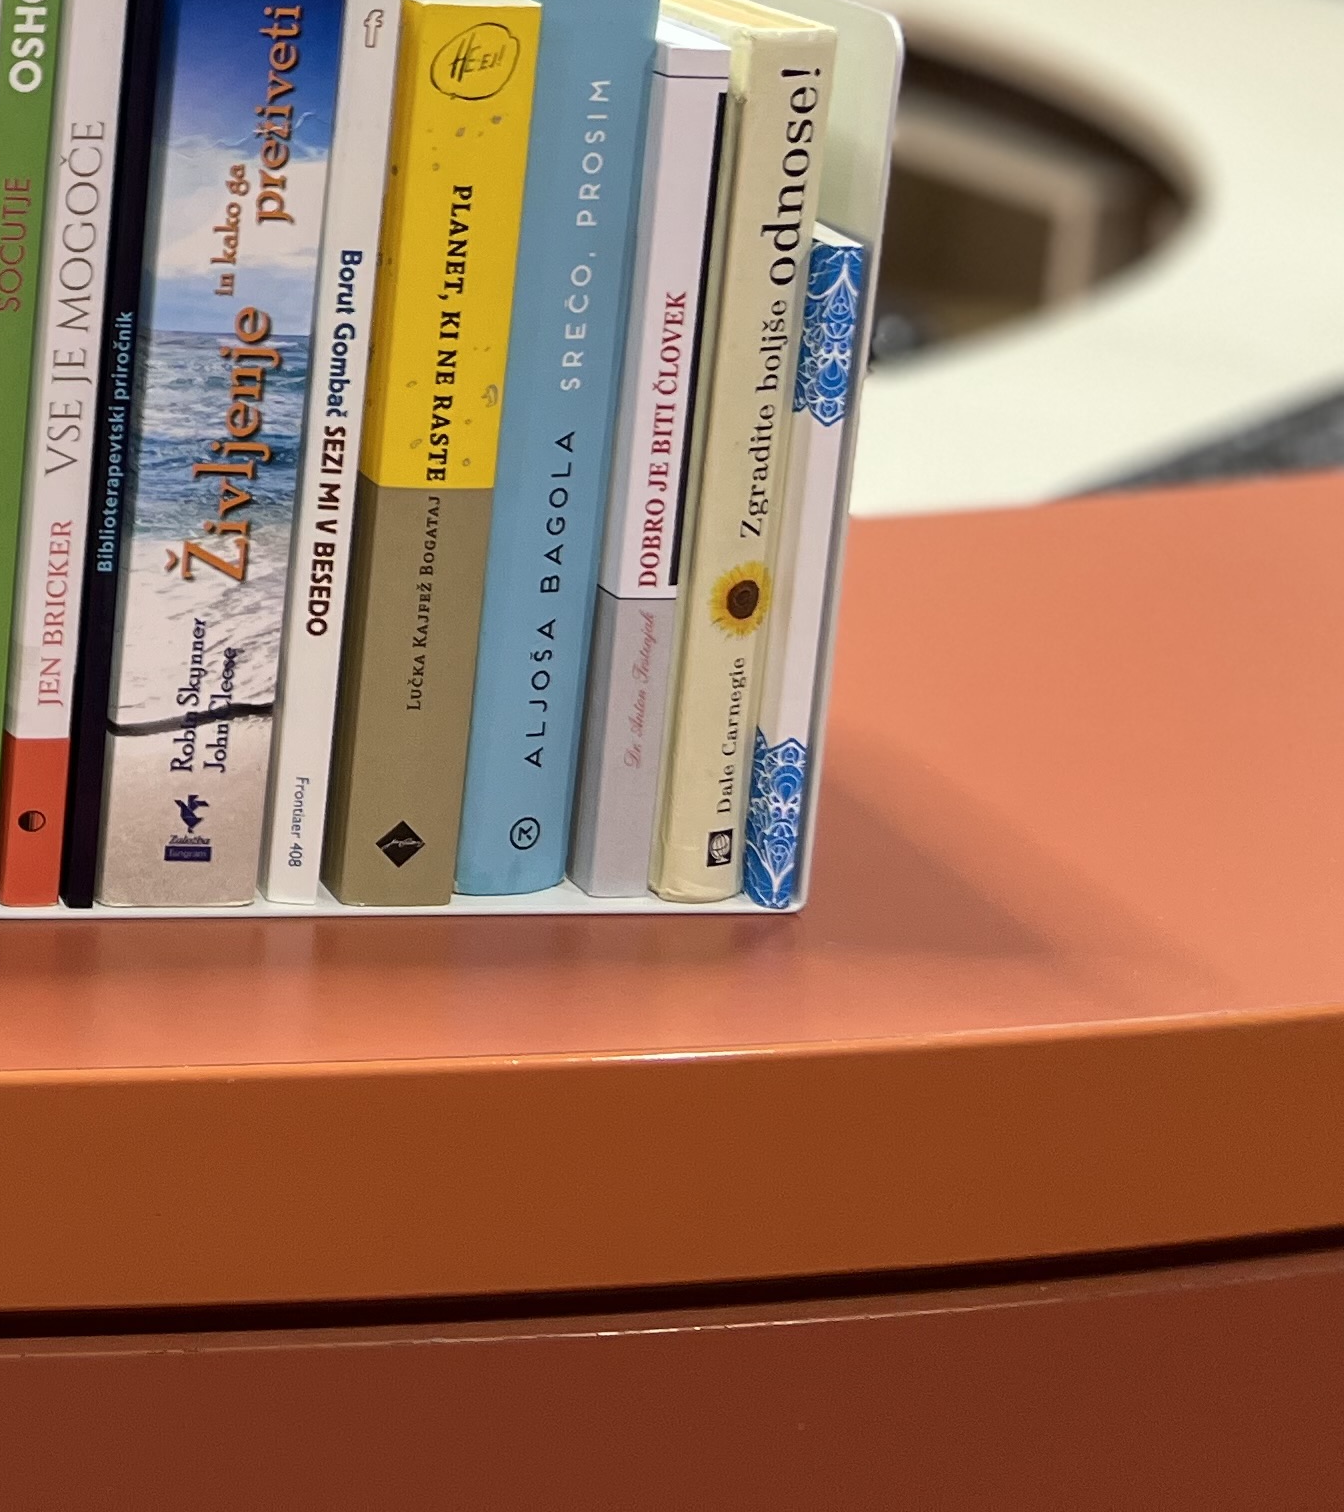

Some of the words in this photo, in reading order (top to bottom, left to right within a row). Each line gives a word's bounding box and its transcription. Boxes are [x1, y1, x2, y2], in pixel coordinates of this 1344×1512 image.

[256, 5, 304, 226] preživeti
[575, 80, 611, 226] PROSIM
[760, 67, 823, 287] odnose!
[55, 121, 105, 332] MOGOČE
[210, 201, 242, 266] kako
[437, 184, 473, 301] PLANET,
[214, 272, 236, 298] in
[335, 249, 363, 315] Borut
[439, 310, 461, 340] KI
[51, 347, 92, 385] JE
[110, 311, 133, 400] priročnik
[325, 322, 356, 418] Gombač
[435, 349, 458, 385] NE
[652, 292, 686, 395] ČLOVEK
[755, 300, 788, 392] boljše
[44, 399, 83, 475] VSE
[164, 305, 282, 585] Življenje
[320, 425, 346, 475] SEZI
[426, 395, 453, 481] RASTE
[650, 403, 675, 455] BITI
[739, 404, 775, 538] Zgradite
[96, 405, 125, 572] Biblioterapevtski
[317, 482, 341, 511] MI
[539, 431, 575, 593] BAGOLA
[647, 462, 669, 492] JE
[315, 519, 338, 535] V
[418, 496, 440, 576] BOGATAJ
[637, 498, 665, 587] DOBRO
[42, 520, 72, 646] BRICKER
[305, 541, 336, 636] BESEDO
[411, 582, 432, 648] KAJFEŽ
[37, 657, 63, 707] JEN
[406, 654, 426, 710] LUČKA
[523, 618, 556, 768] ALJOŠA
[721, 657, 746, 756] Carnegie
[716, 764, 734, 813] Dale
